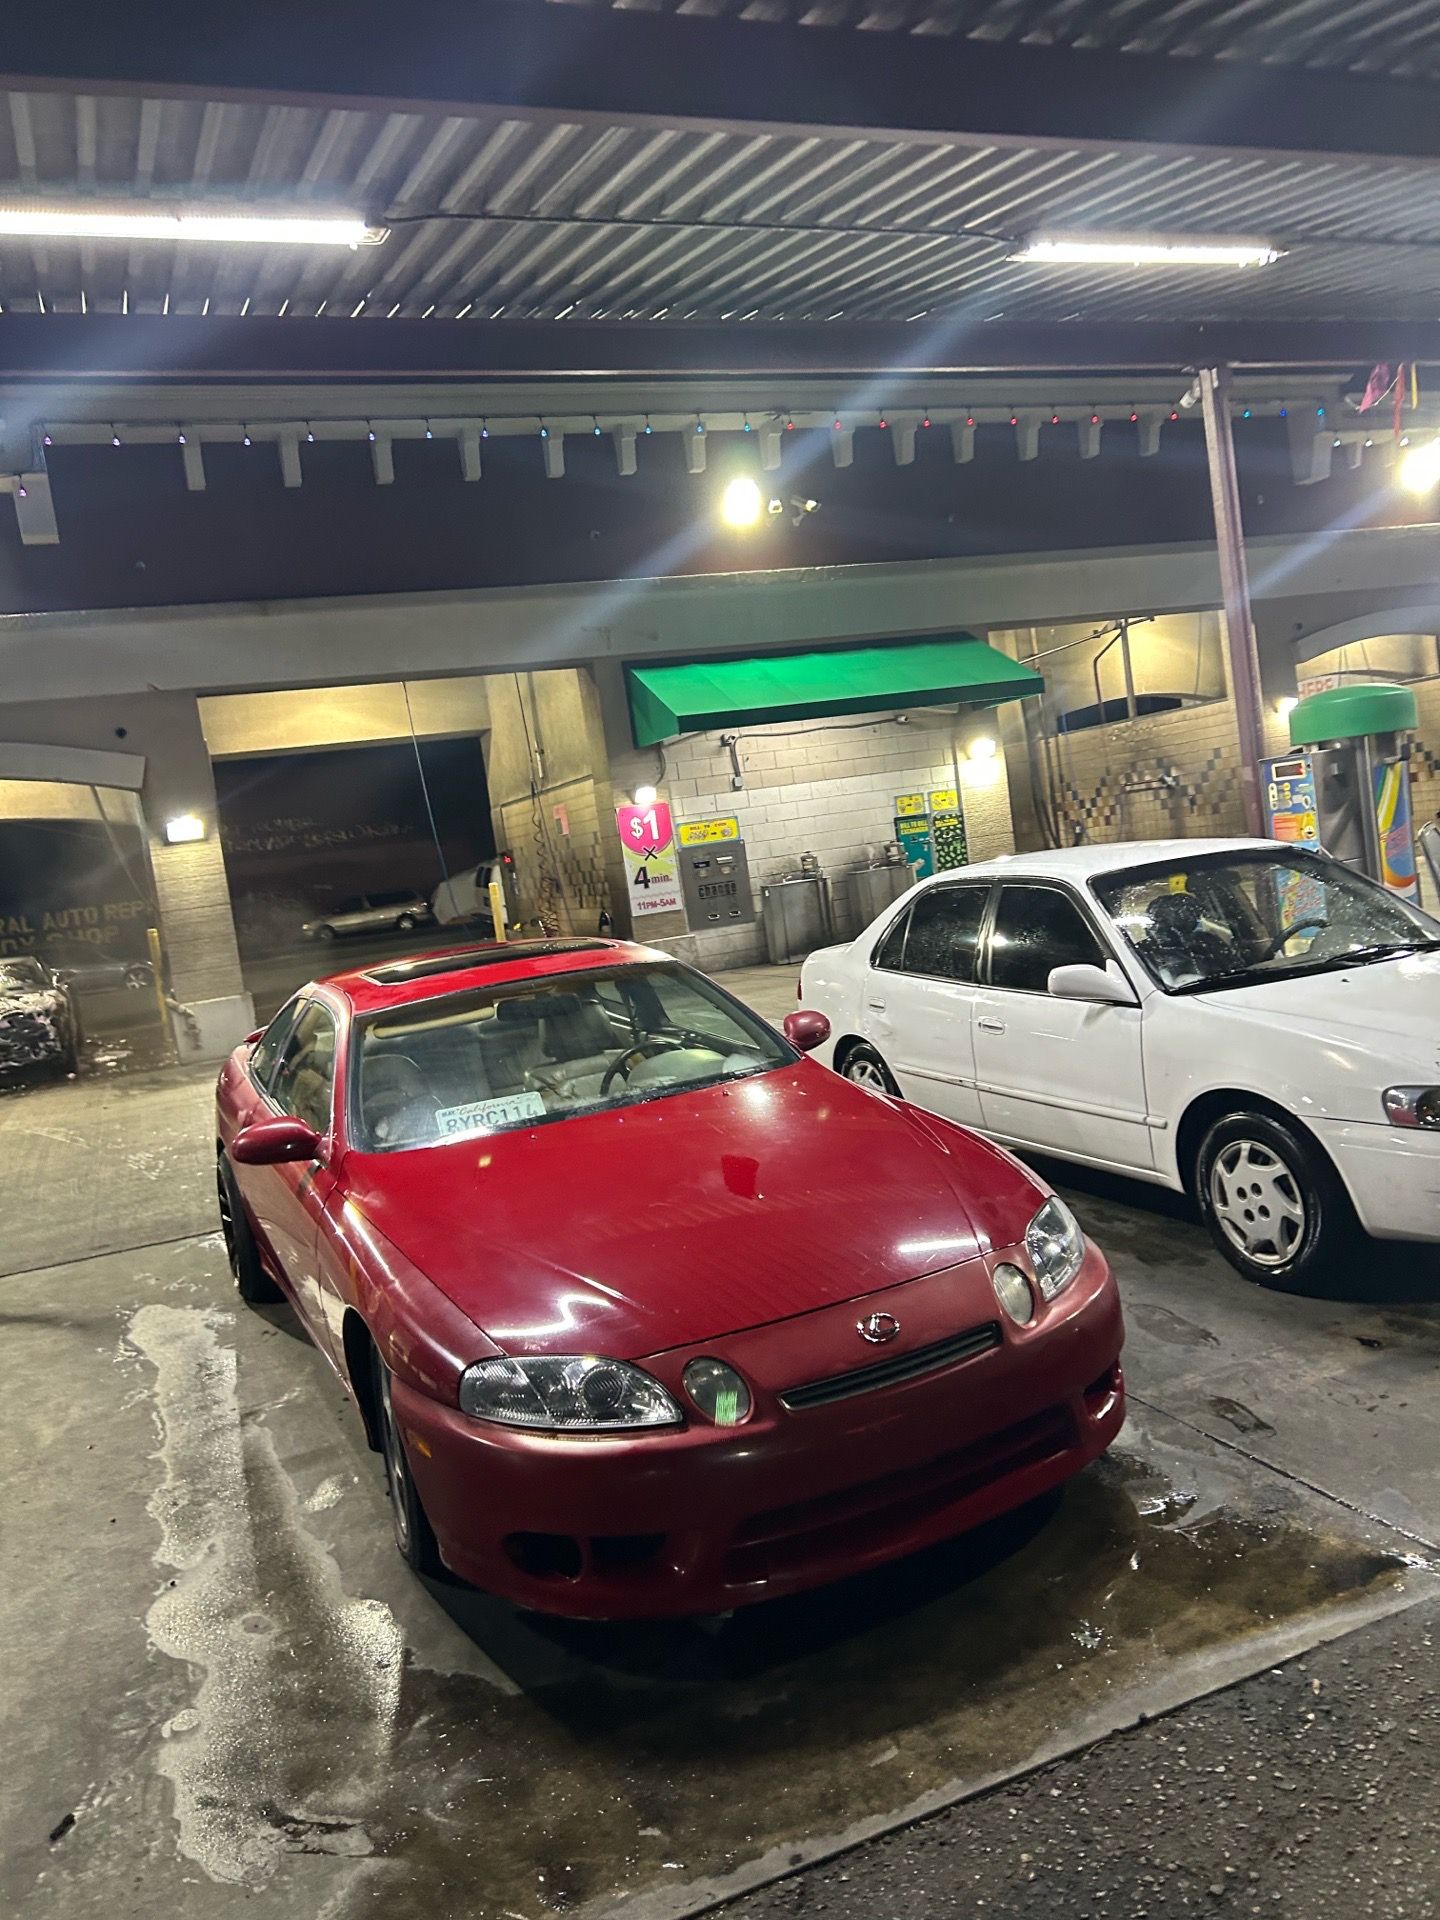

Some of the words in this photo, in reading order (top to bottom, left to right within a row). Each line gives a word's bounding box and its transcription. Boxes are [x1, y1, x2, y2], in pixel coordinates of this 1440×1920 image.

[630, 809, 660, 840] $1
[634, 866, 651, 889] 4
[650, 873, 673, 884] min.
[636, 897, 677, 911] 11PM-5AM
[43, 907, 98, 930] AUTO
[458, 1099, 516, 1116] California
